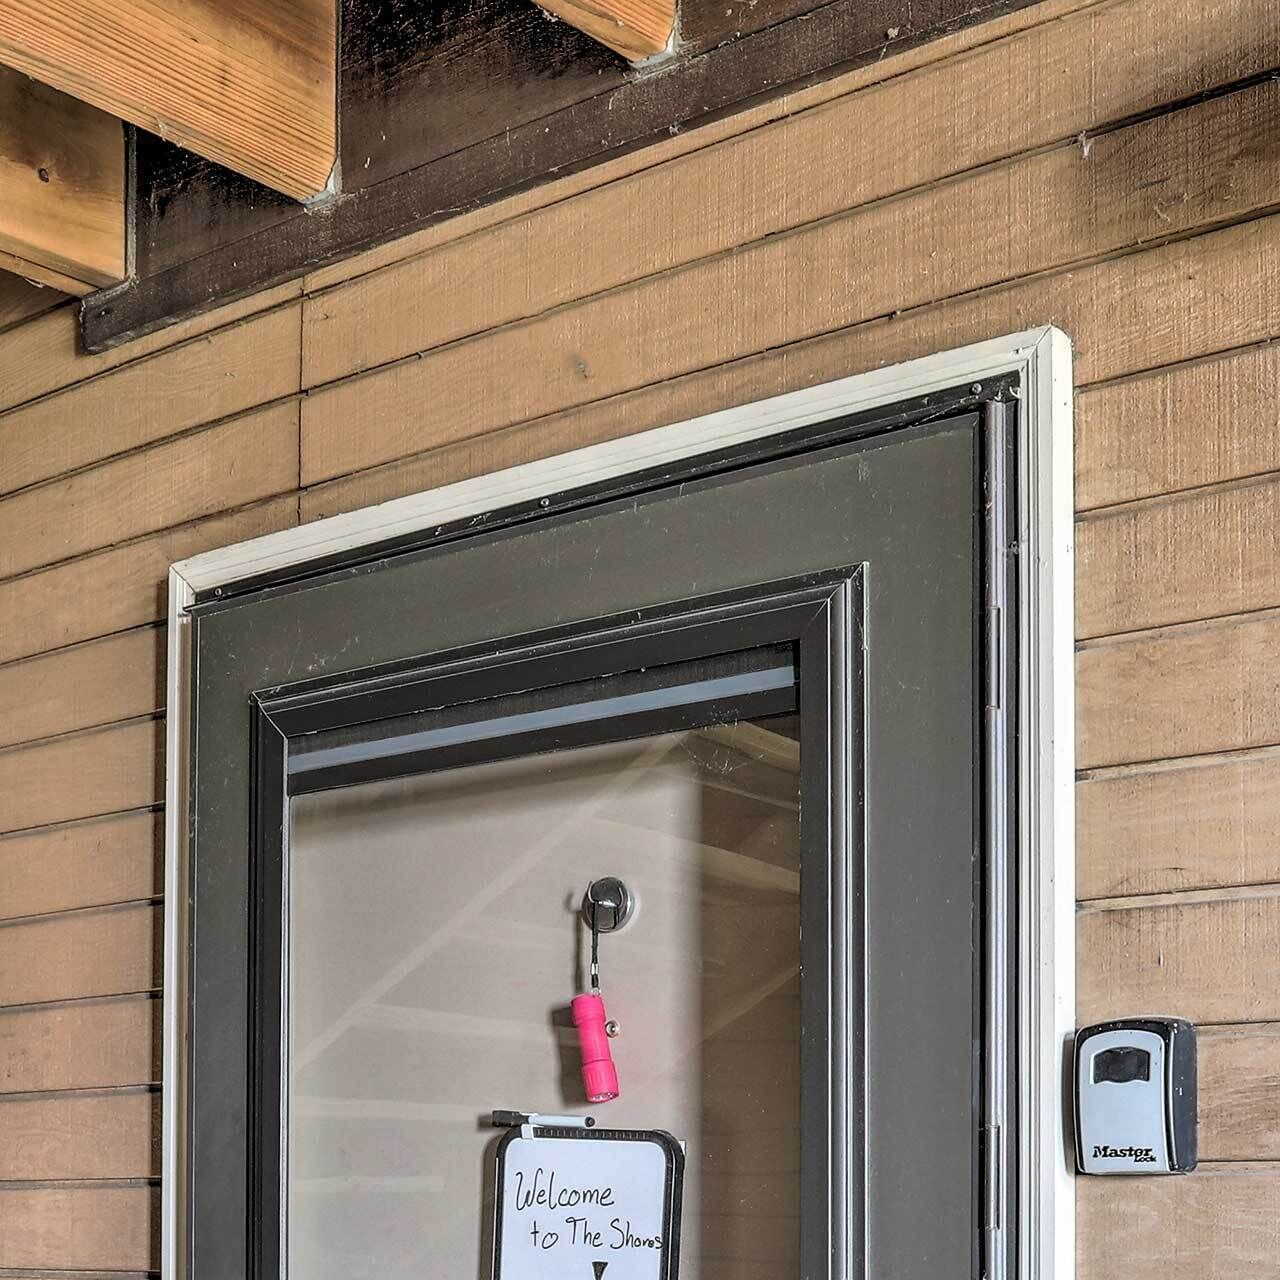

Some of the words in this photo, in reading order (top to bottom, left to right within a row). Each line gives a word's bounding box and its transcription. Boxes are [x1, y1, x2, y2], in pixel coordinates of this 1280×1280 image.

[1092, 1145, 1153, 1158] Master
[1133, 1154, 1157, 1162] Lock
[515, 1167, 615, 1211] Welcome
[530, 1219, 559, 1250] to
[565, 1216, 604, 1248] The
